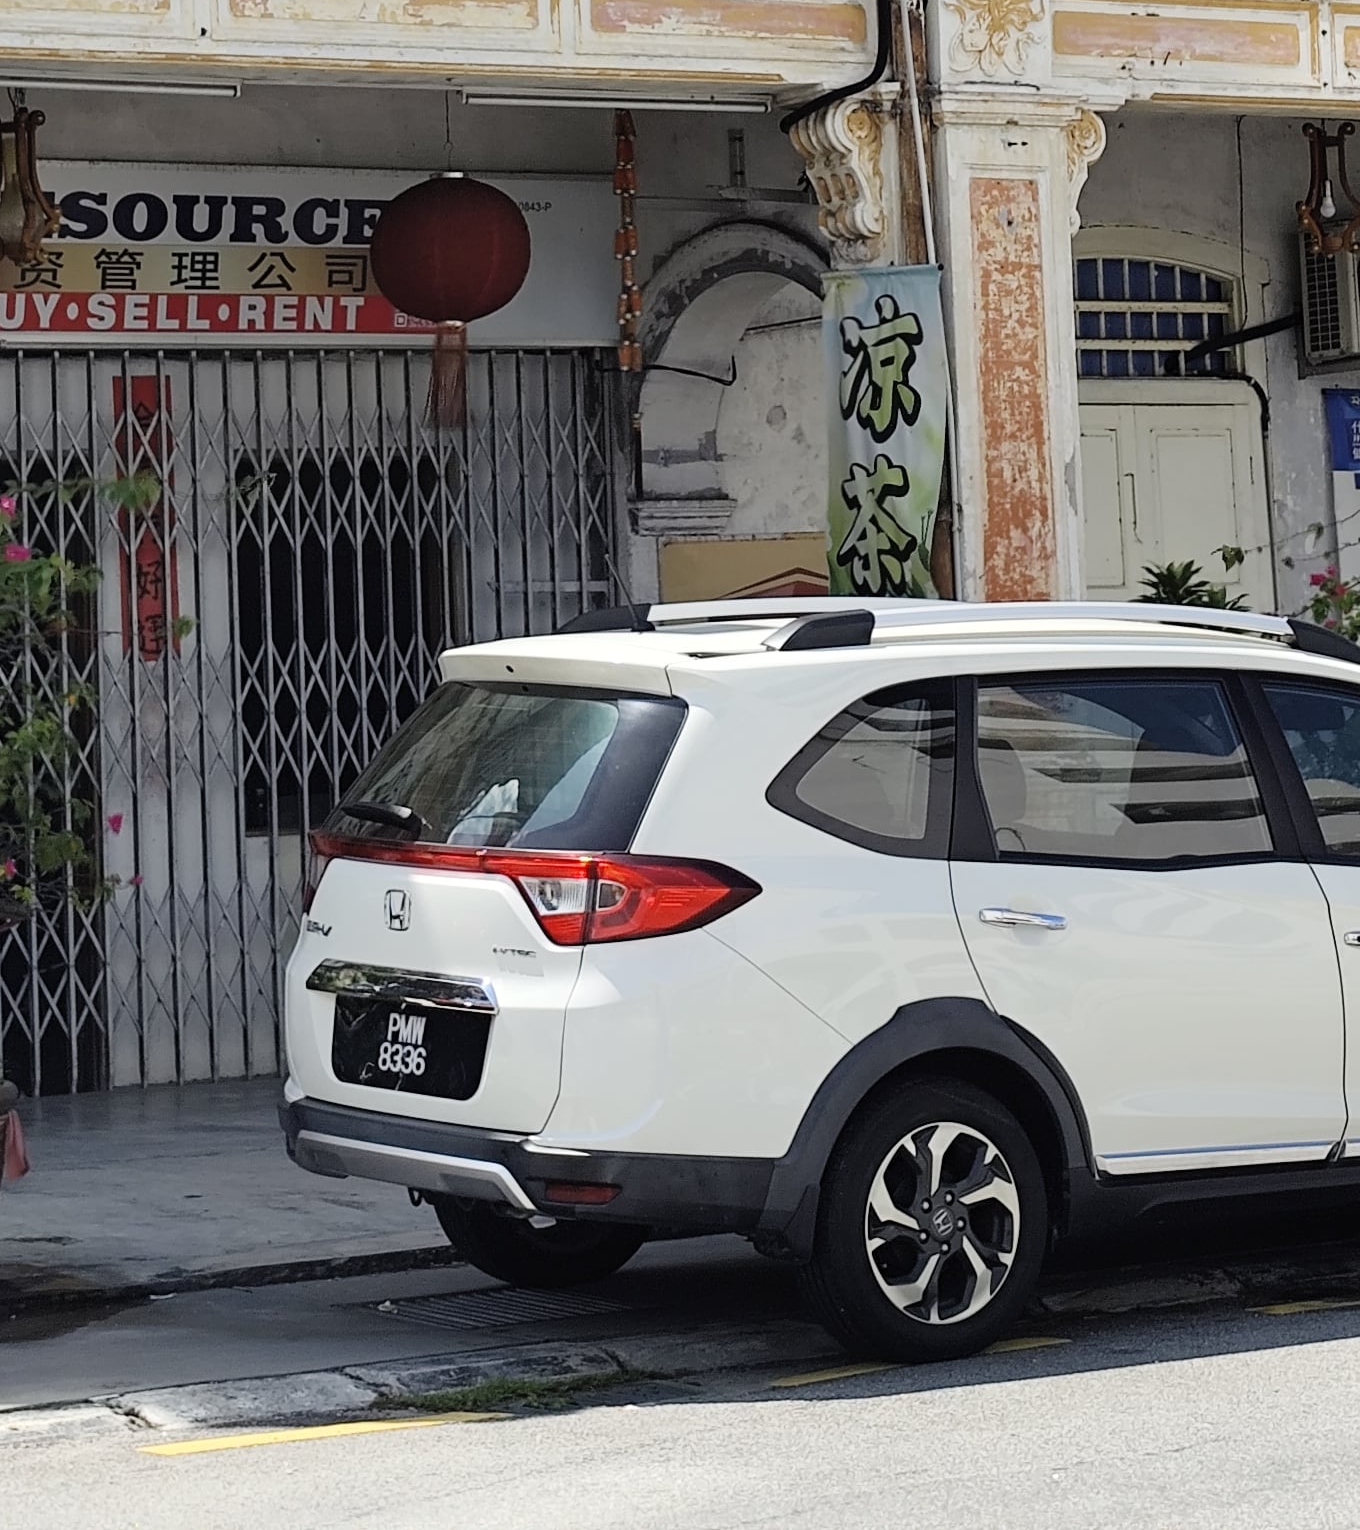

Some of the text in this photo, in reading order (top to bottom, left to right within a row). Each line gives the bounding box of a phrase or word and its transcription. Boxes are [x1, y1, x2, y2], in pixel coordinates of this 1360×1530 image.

[837, 293, 924, 596] 凉茶
[387, 1013, 427, 1045] PMW
[378, 1041, 427, 1076] 8336
